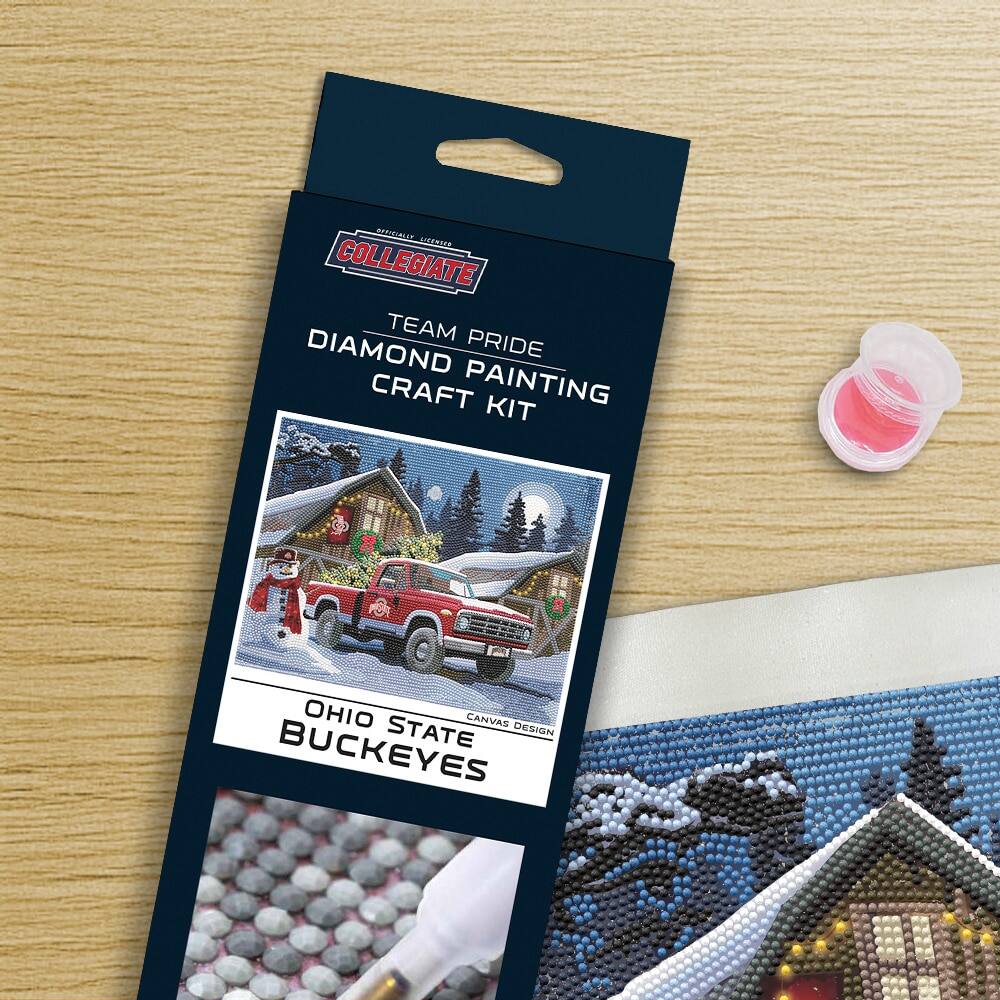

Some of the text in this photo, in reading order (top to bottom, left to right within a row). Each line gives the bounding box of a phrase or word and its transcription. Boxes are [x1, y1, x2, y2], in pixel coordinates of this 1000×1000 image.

[376, 228, 452, 247] OFFICIALLY LICENSED
[336, 239, 479, 285] COLLEGIATE
[388, 312, 544, 358] TEAM PRIDE
[307, 328, 610, 404] DIAMOND PAINTING
[372, 373, 536, 420] CRAFT KIT
[304, 699, 474, 748] OHIO STATE
[466, 712, 554, 736] CANVAS DESIGN
[280, 718, 488, 782] BUCKEYES
